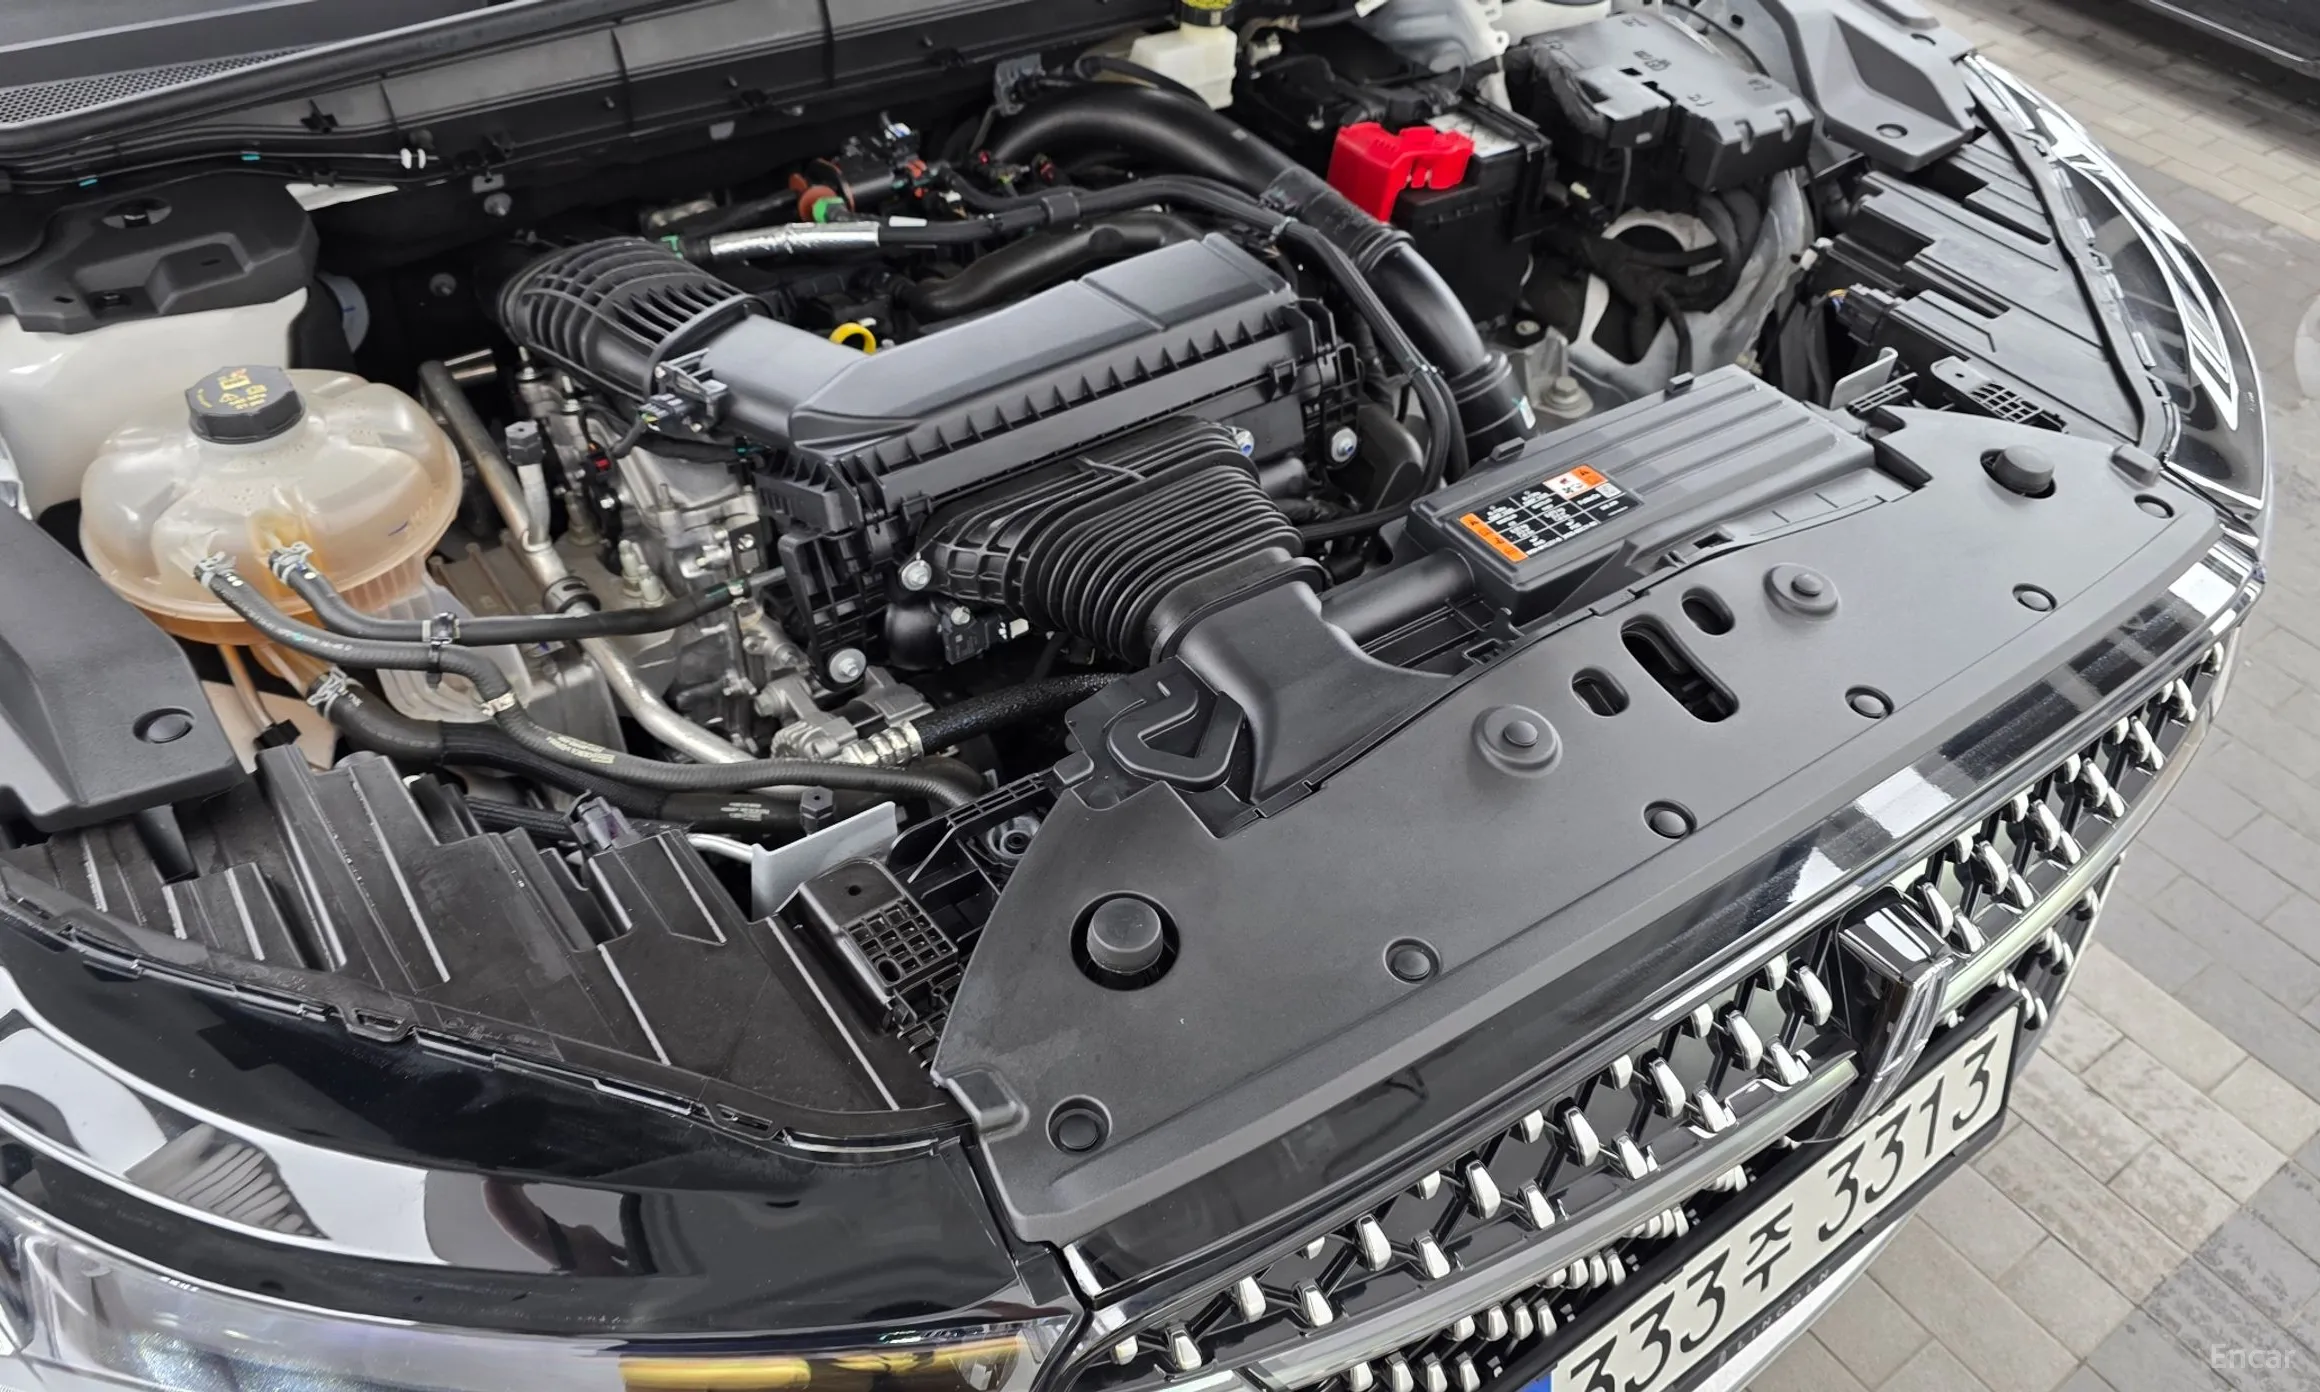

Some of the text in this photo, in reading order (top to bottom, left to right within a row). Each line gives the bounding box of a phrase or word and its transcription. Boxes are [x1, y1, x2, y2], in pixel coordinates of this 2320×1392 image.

[1570, 1036, 1999, 1392] 333주 3313
[1736, 1269, 1829, 1351] LINCOLN
